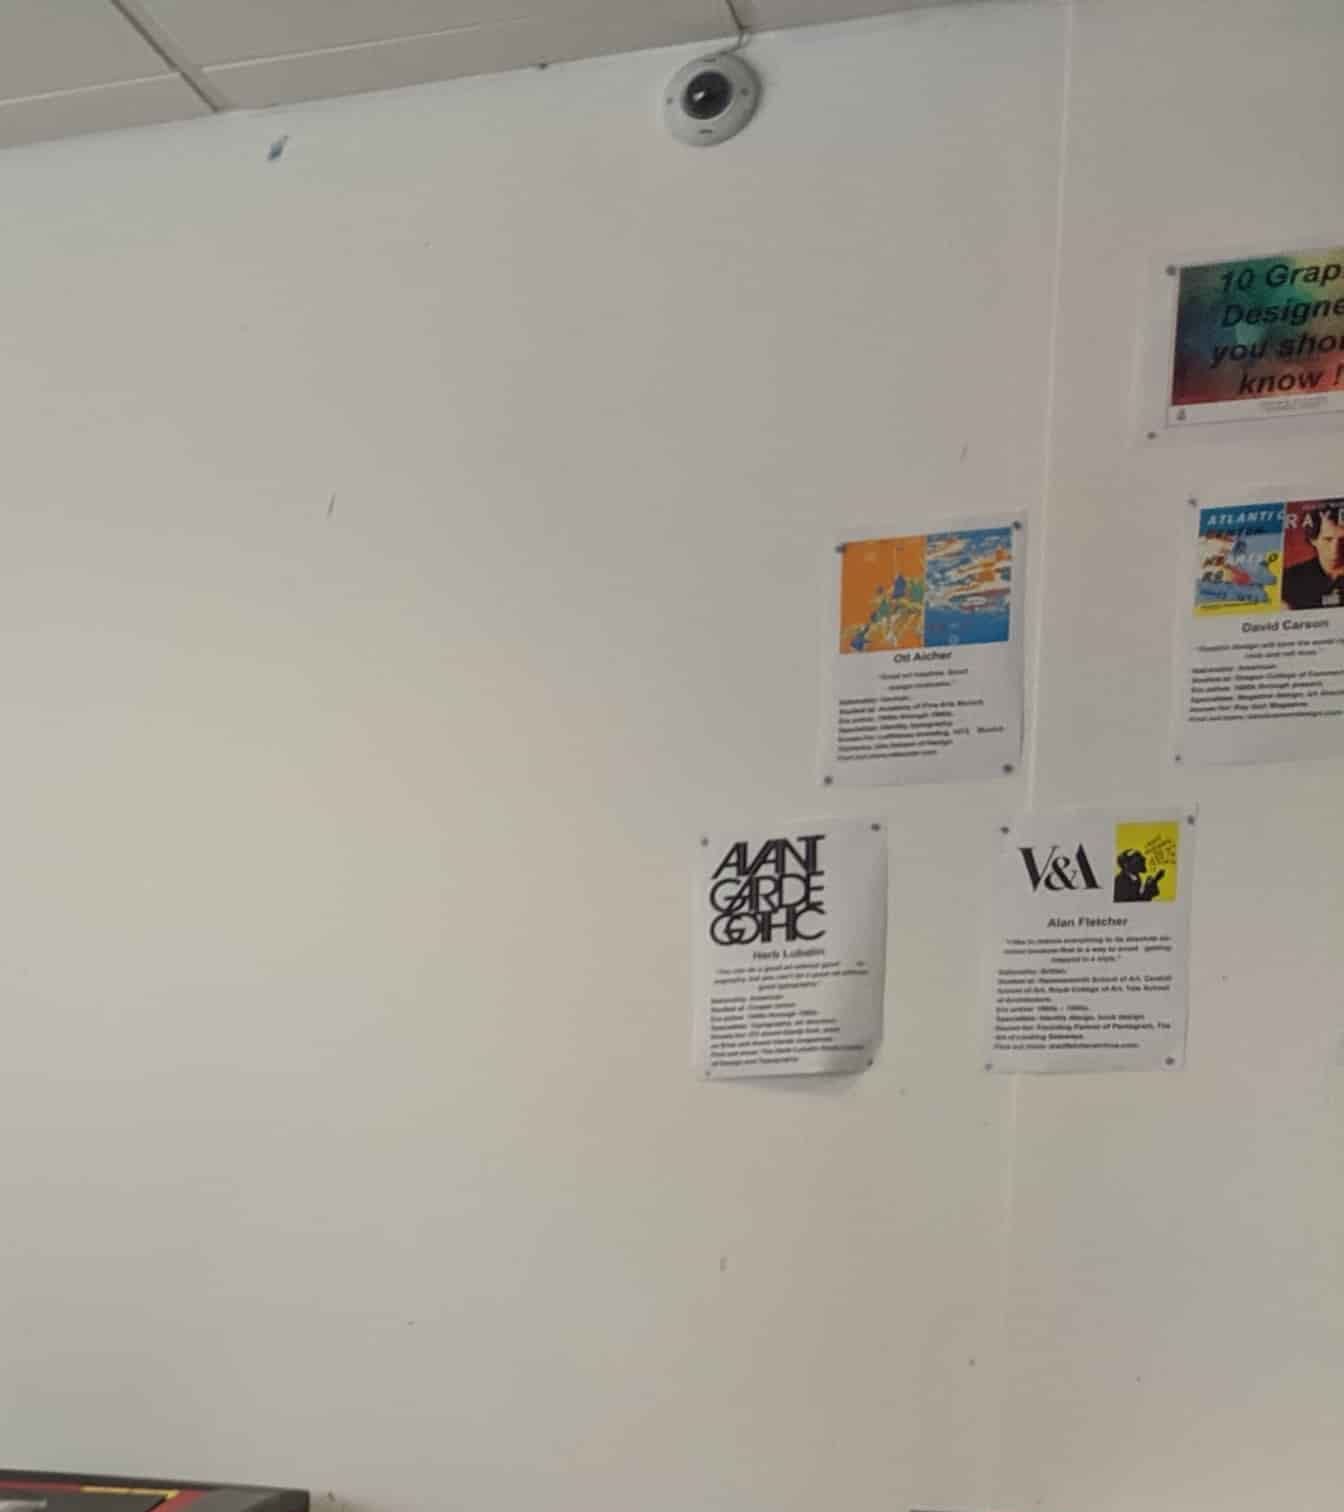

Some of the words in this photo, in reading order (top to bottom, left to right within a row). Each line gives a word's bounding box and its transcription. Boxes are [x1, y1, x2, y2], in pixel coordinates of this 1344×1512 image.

[1221, 266, 1255, 293] 10
[1265, 263, 1344, 288] Grap
[1210, 341, 1265, 369] you
[1239, 371, 1323, 396] know
[1207, 511, 1287, 526] ATLANTIC
[1241, 621, 1280, 633] David
[1282, 619, 1329, 632] Carson
[913, 651, 953, 662] Aicher
[710, 834, 826, 881] AVANT
[1018, 842, 1105, 893] V&A
[710, 871, 825, 917] GARDE
[1047, 917, 1075, 928] Alan
[1077, 915, 1129, 928] Fletcher
